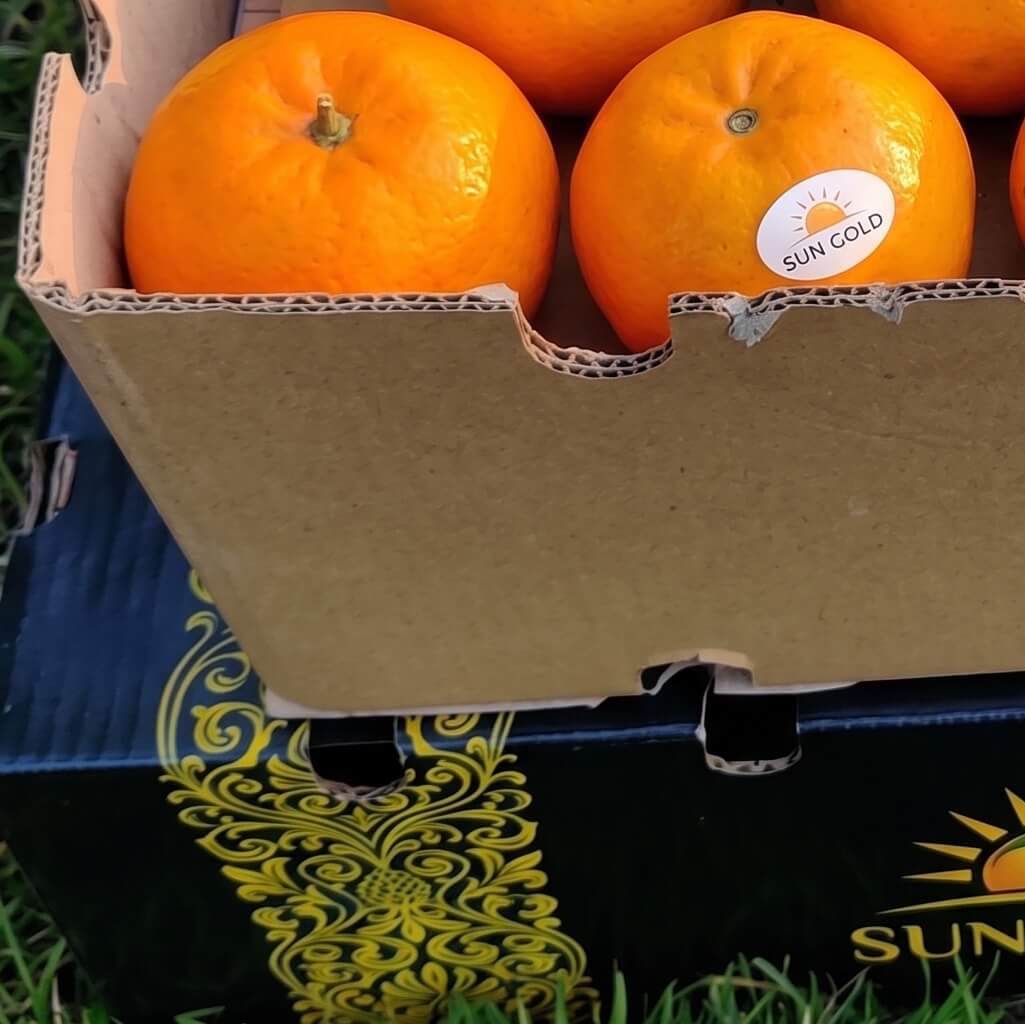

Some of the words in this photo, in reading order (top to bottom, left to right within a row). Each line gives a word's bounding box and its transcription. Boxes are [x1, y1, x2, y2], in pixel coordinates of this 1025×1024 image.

[783, 241, 826, 272] SUN
[830, 213, 883, 249] GOLD
[851, 919, 1025, 962] SUN
